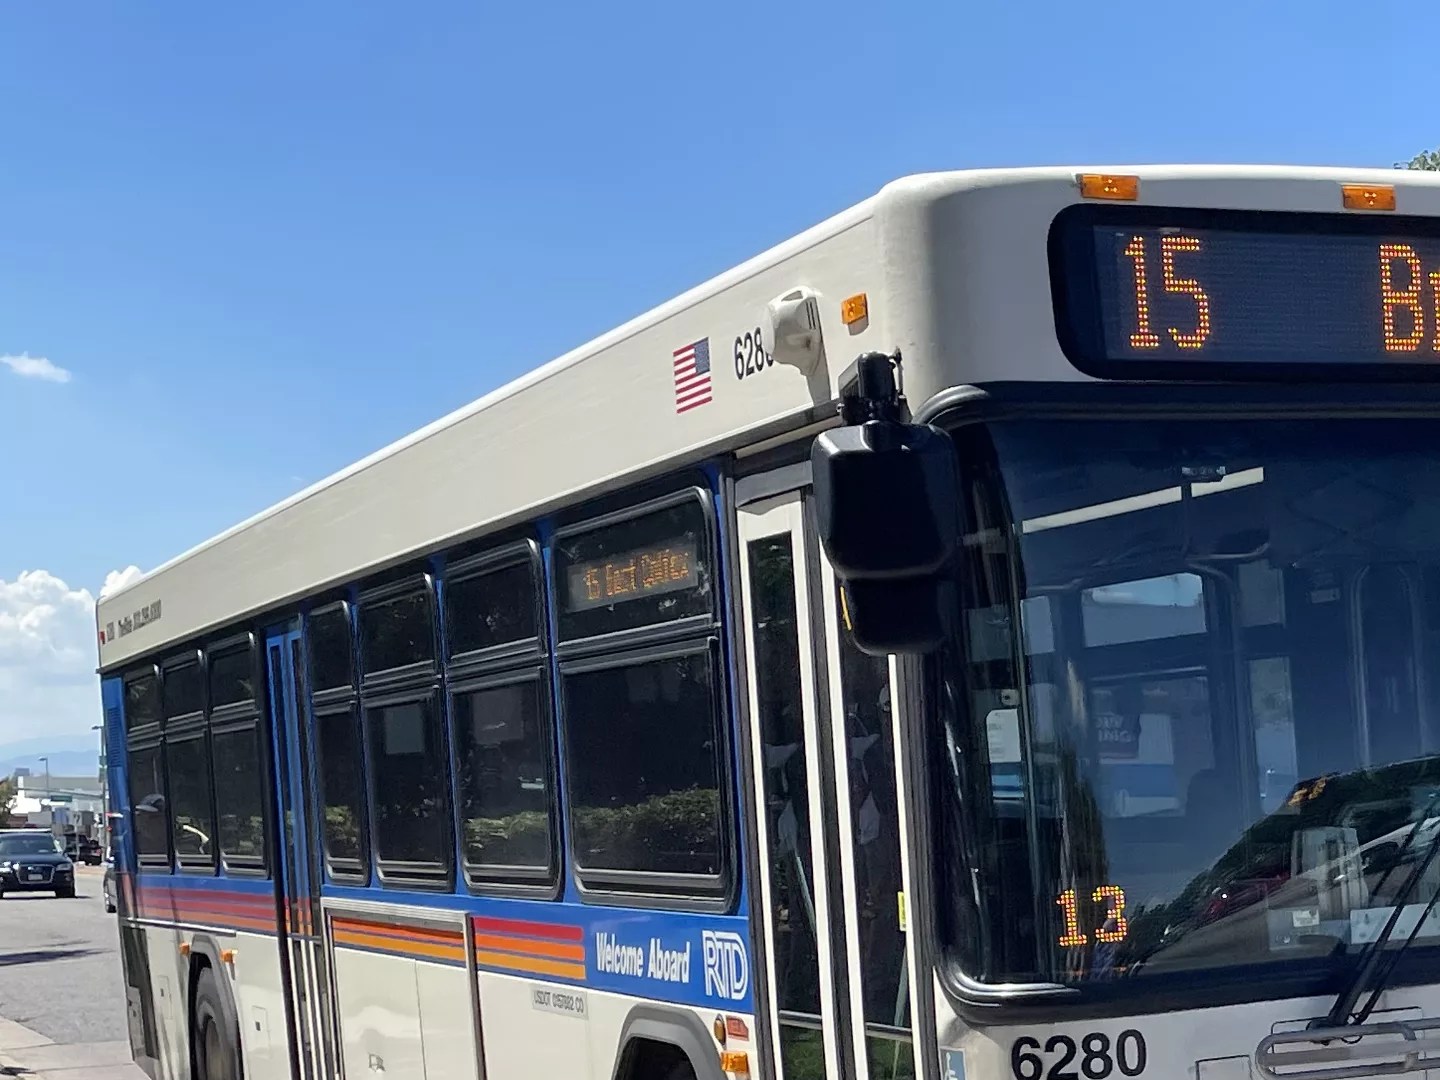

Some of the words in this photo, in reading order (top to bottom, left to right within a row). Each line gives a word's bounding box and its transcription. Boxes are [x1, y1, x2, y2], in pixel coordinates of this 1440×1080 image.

[1125, 235, 1210, 350] 15
[1056, 886, 1126, 946] 13
[596, 932, 644, 978] Welcome
[647, 938, 691, 983] Aboard
[702, 930, 749, 1000] RTD
